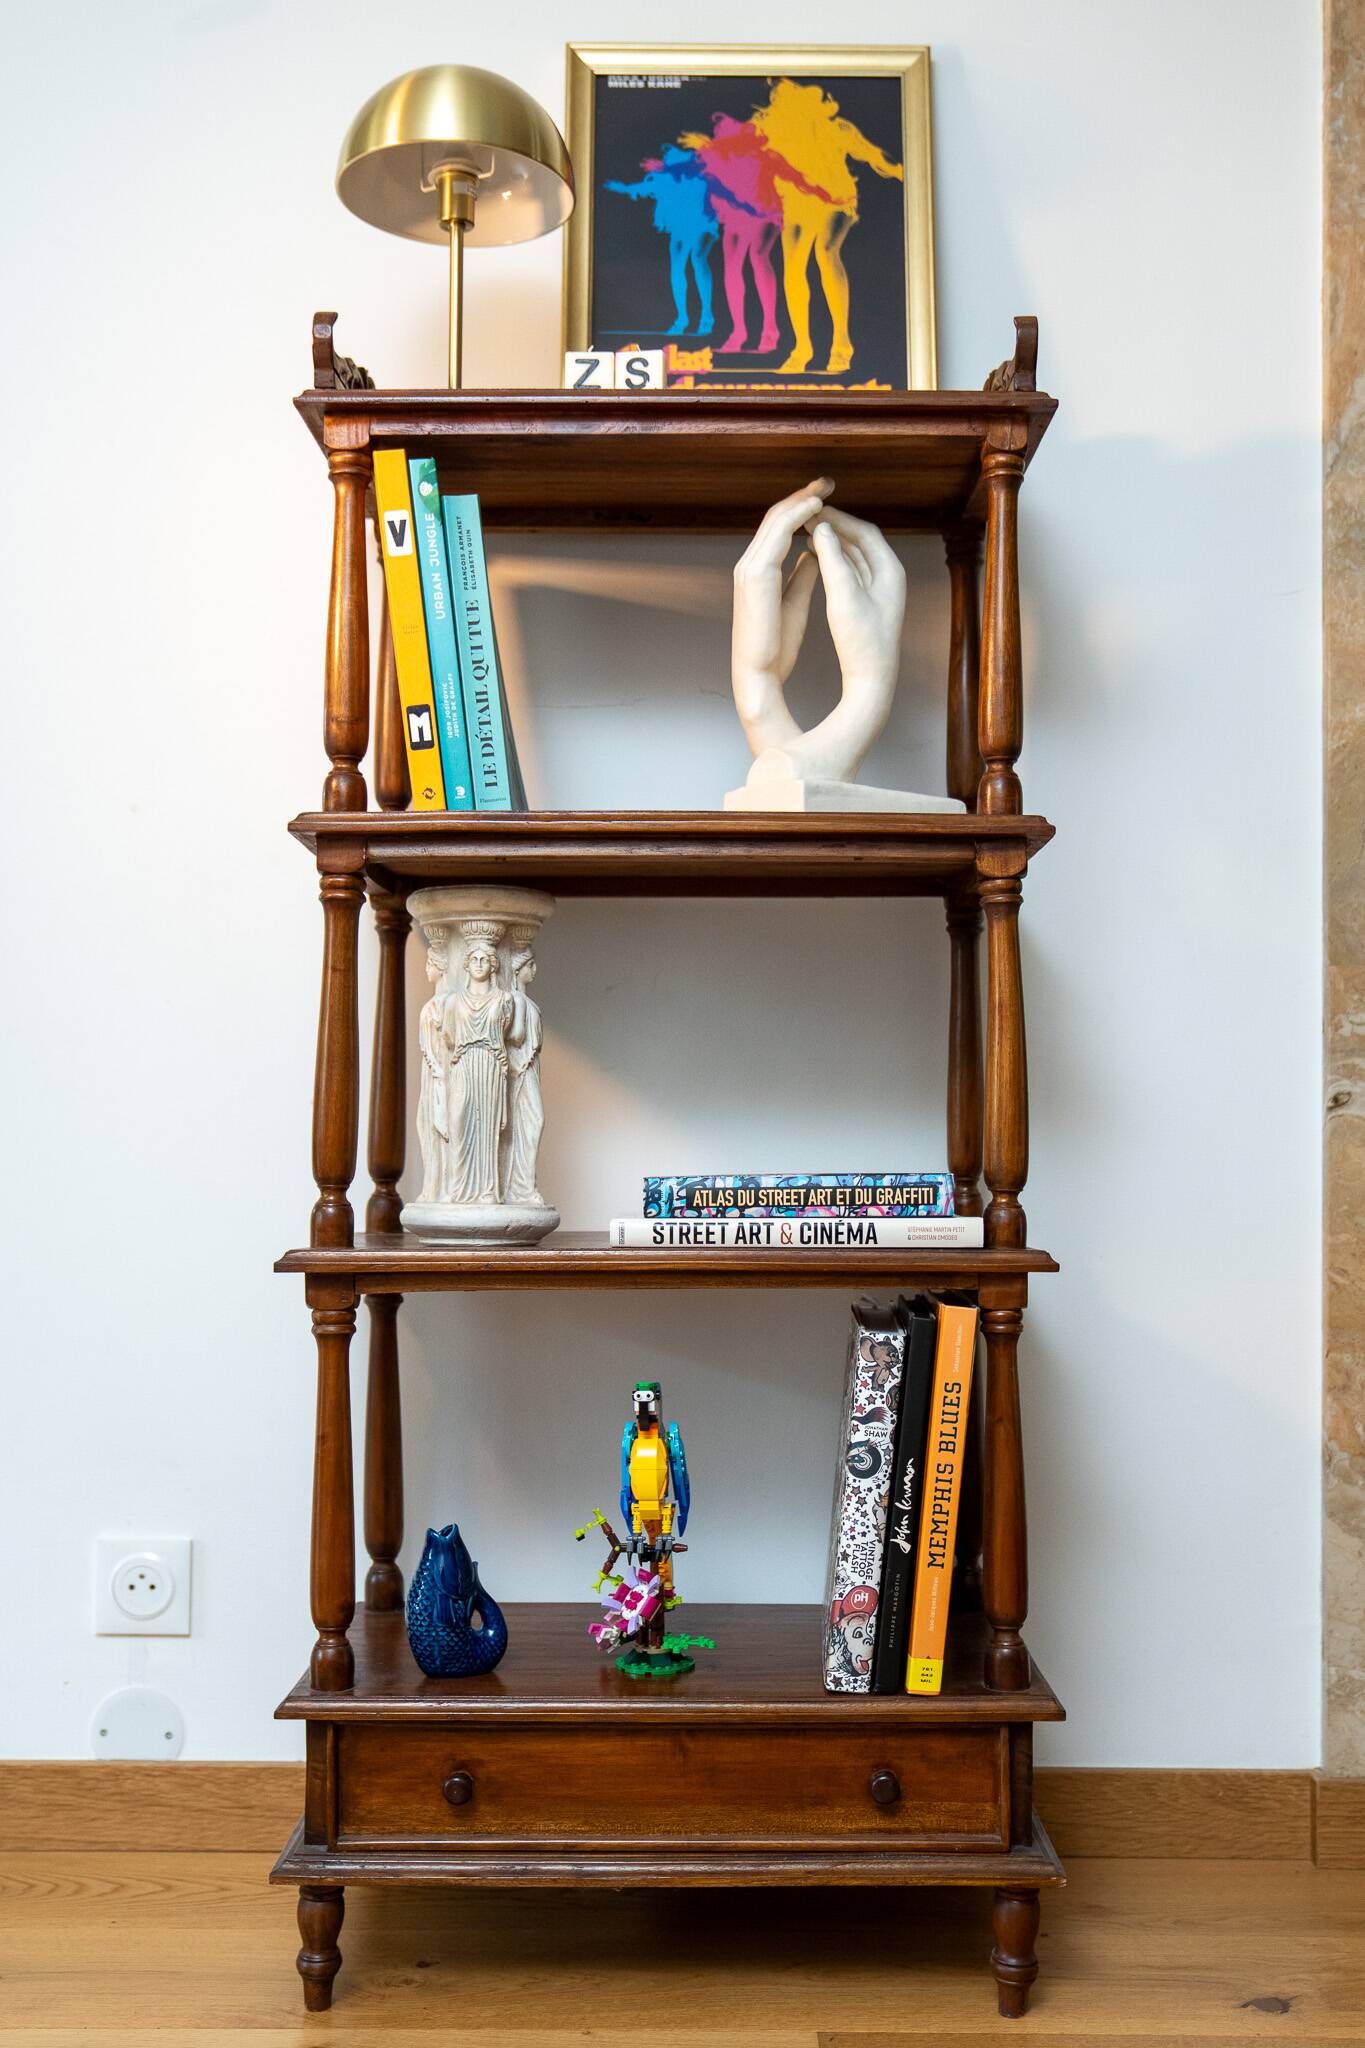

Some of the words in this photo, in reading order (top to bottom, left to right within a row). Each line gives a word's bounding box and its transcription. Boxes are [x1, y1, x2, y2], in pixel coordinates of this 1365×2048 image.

[573, 358, 602, 389] Z
[625, 357, 650, 389] S
[387, 519, 407, 548] V
[425, 513, 440, 567] JUNGLE
[456, 516, 464, 551] ARMANET
[432, 573, 446, 620] URBAN
[465, 600, 482, 641] TUE
[470, 645, 489, 681] QUI
[409, 711, 433, 743] M
[475, 684, 495, 757] DÉTAIL
[482, 763, 498, 787] LE
[693, 1189, 733, 1207] ATLAS
[737, 1189, 754, 1207] DU
[758, 1188, 806, 1207] STREET
[808, 1188, 833, 1206] ART
[836, 1188, 851, 1205] ET
[855, 1188, 872, 1205] DU
[876, 1187, 933, 1205] GRAFFITI
[652, 1222, 729, 1245] STREET
[734, 1222, 774, 1245] ART
[780, 1222, 793, 1245] &
[800, 1219, 878, 1245] CINÉMA
[938, 1381, 962, 1454] BLUES
[928, 1463, 954, 1569] MEMPHIS
[851, 1543, 860, 1573] FLASH
[858, 1542, 868, 1577] TATTOO
[866, 1540, 876, 1580] VINTAGE
